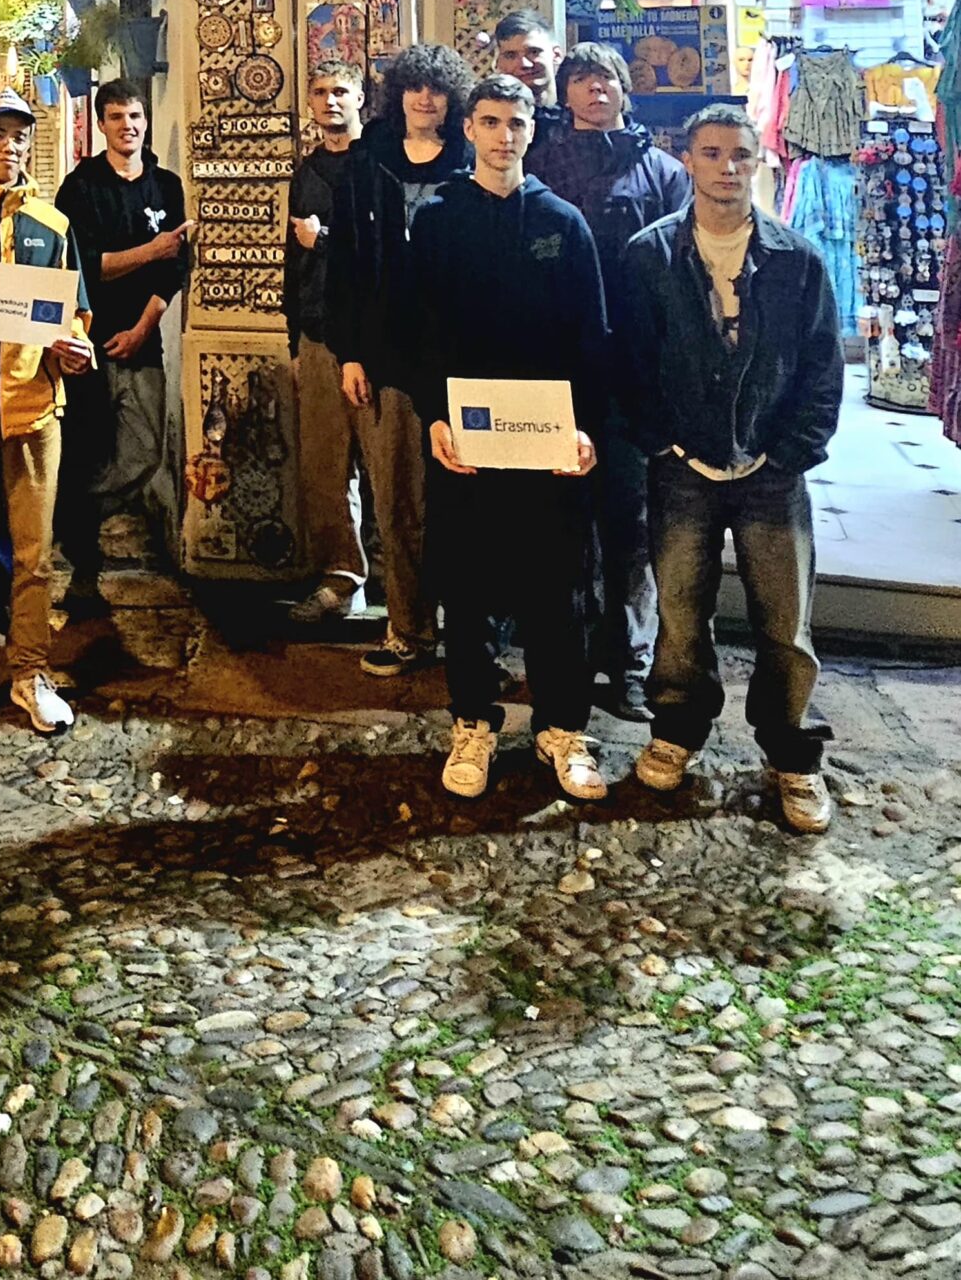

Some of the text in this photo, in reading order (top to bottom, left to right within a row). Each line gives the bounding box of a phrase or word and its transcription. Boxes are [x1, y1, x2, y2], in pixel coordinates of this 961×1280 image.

[220, 118, 269, 132] CHONG
[193, 130, 213, 143] WC
[202, 204, 270, 217] CORDOBA
[231, 249, 278, 261] INARI
[203, 285, 239, 297] HOME
[494, 418, 562, 433] Erasmus+
